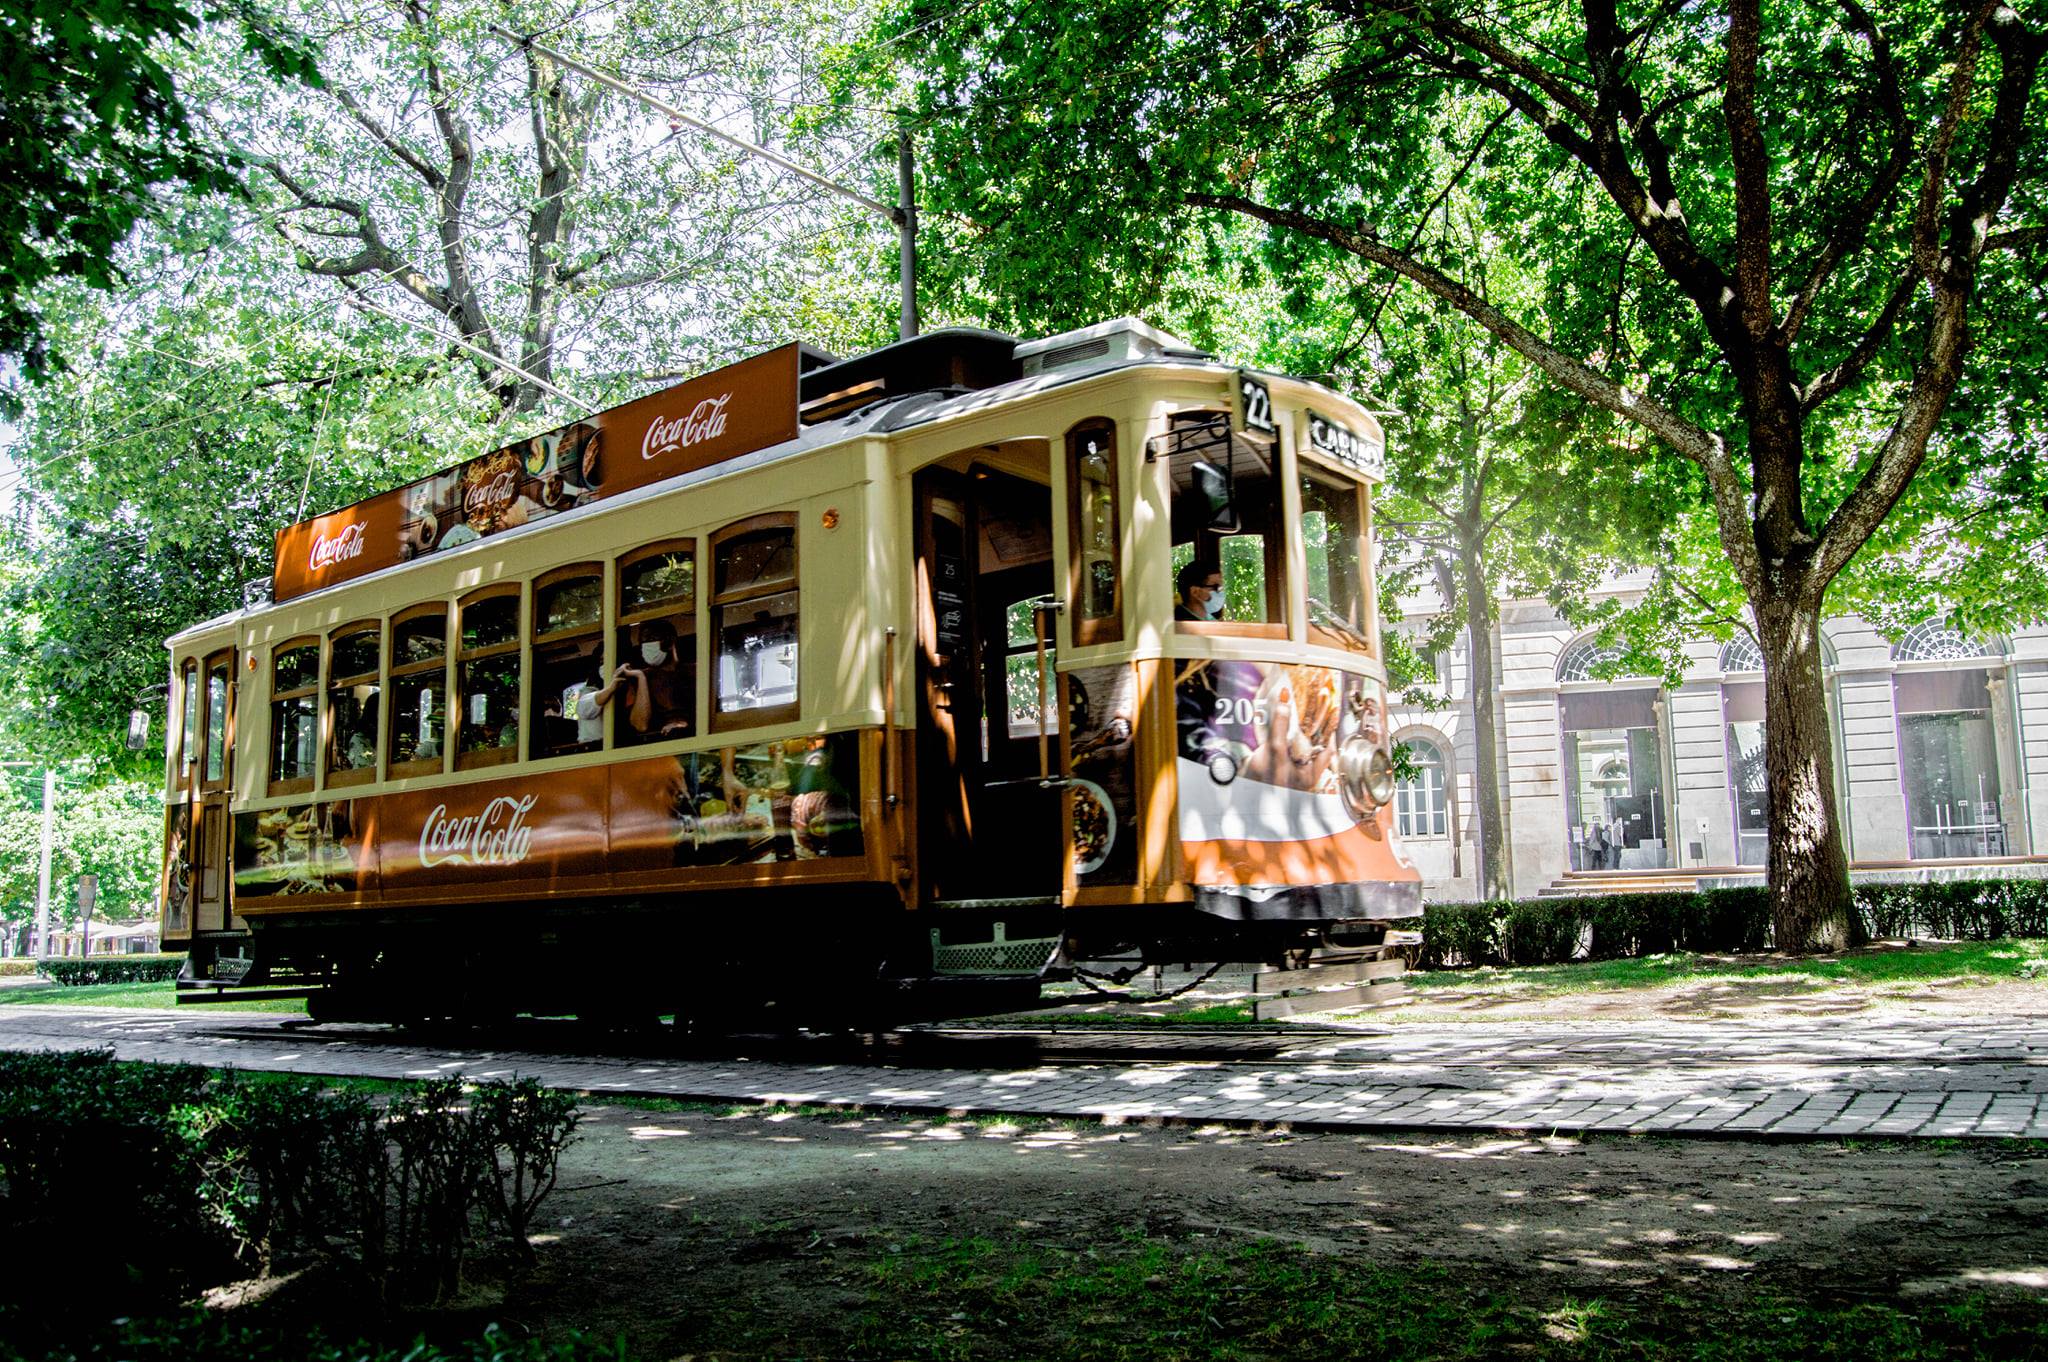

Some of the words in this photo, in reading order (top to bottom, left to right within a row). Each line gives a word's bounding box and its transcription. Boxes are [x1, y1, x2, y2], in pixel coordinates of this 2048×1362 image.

[642, 392, 733, 460] Coca-Cola
[1243, 382, 1273, 430] 22
[1215, 698, 1268, 726] 205
[419, 794, 540, 868] Coca-Cola
